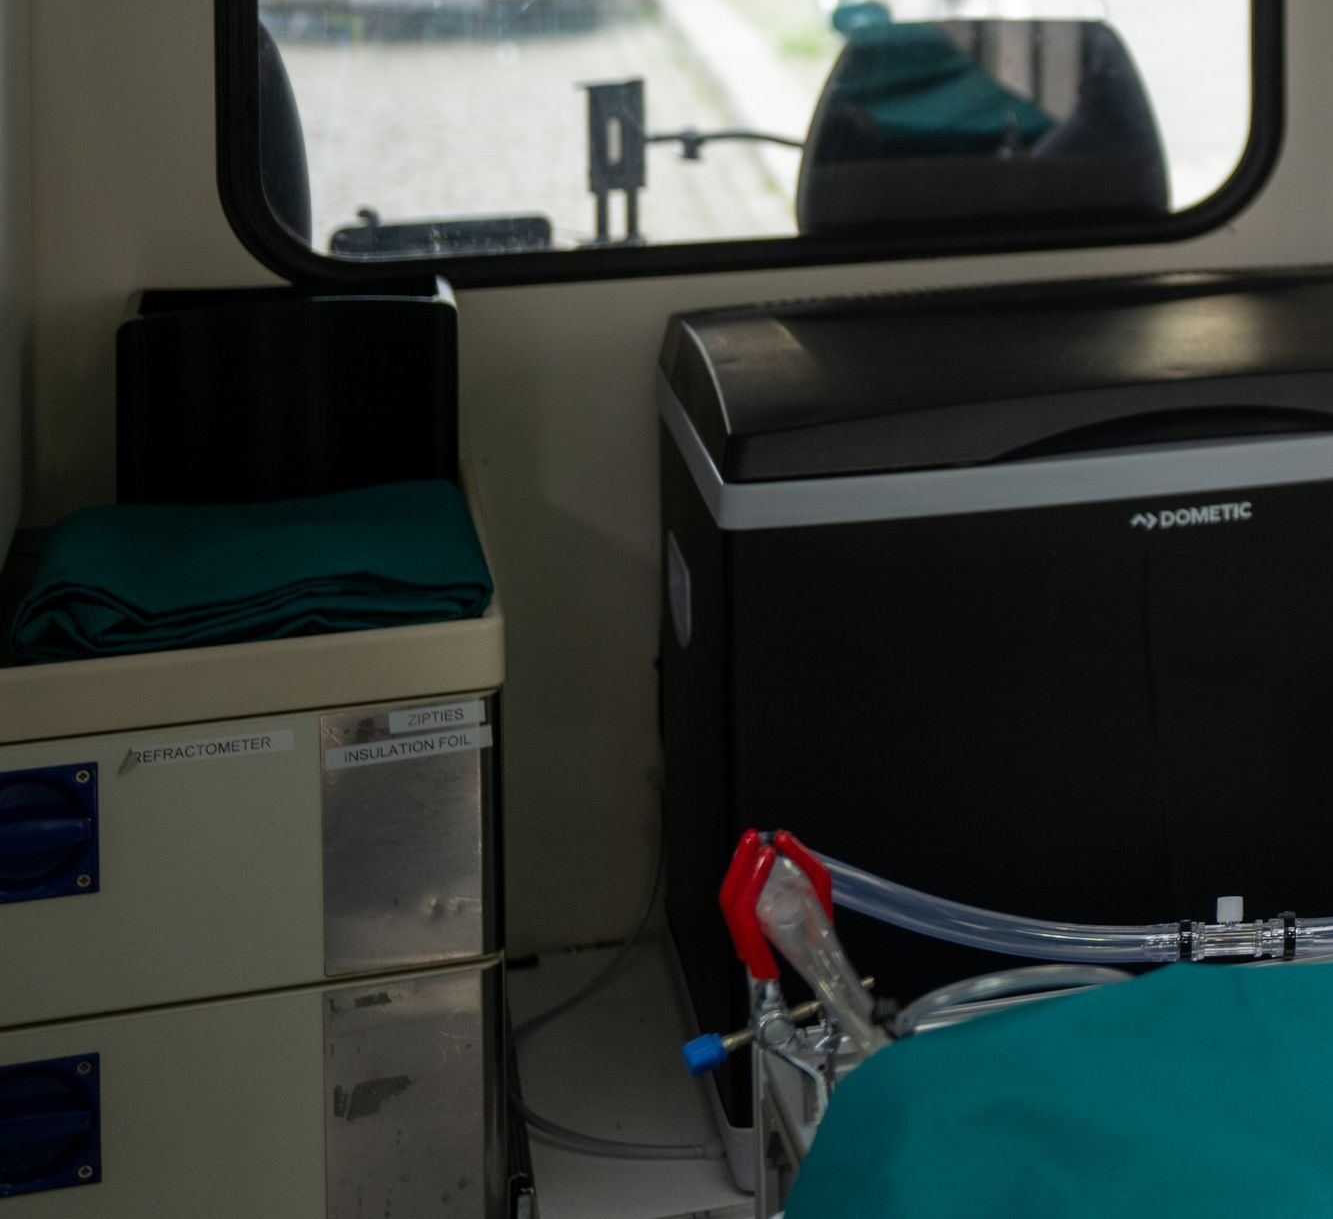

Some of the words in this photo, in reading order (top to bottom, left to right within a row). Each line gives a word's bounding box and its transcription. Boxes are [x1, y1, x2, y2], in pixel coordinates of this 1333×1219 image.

[1159, 501, 1252, 529] DOMETIC
[408, 708, 465, 727] ZIPTIES
[133, 736, 272, 764] REFRACTOMETER
[344, 740, 435, 763] INSULATION
[439, 734, 472, 750] FOIL
